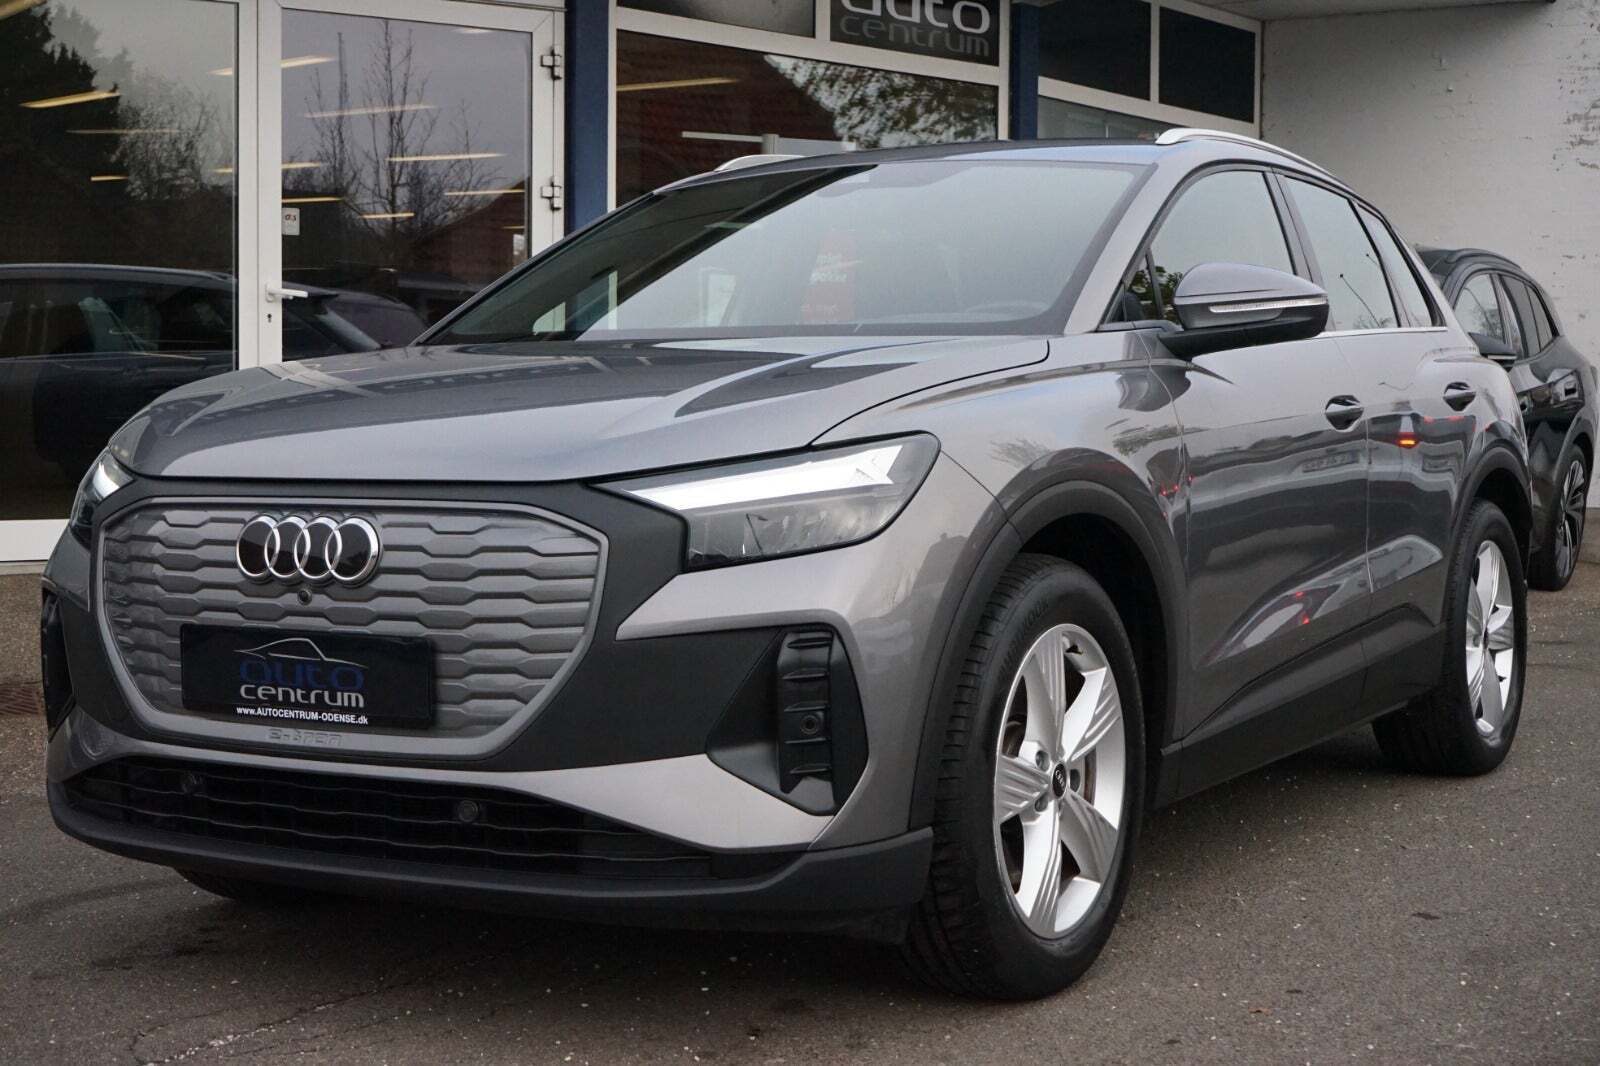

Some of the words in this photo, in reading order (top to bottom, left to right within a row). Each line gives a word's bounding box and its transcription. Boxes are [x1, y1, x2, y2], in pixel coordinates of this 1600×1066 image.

[839, 15, 990, 57] centrum
[239, 659, 365, 690] auto
[239, 684, 365, 708] centrum
[236, 707, 368, 724] www.AUTOCENTRUM-ODENSE.dk
